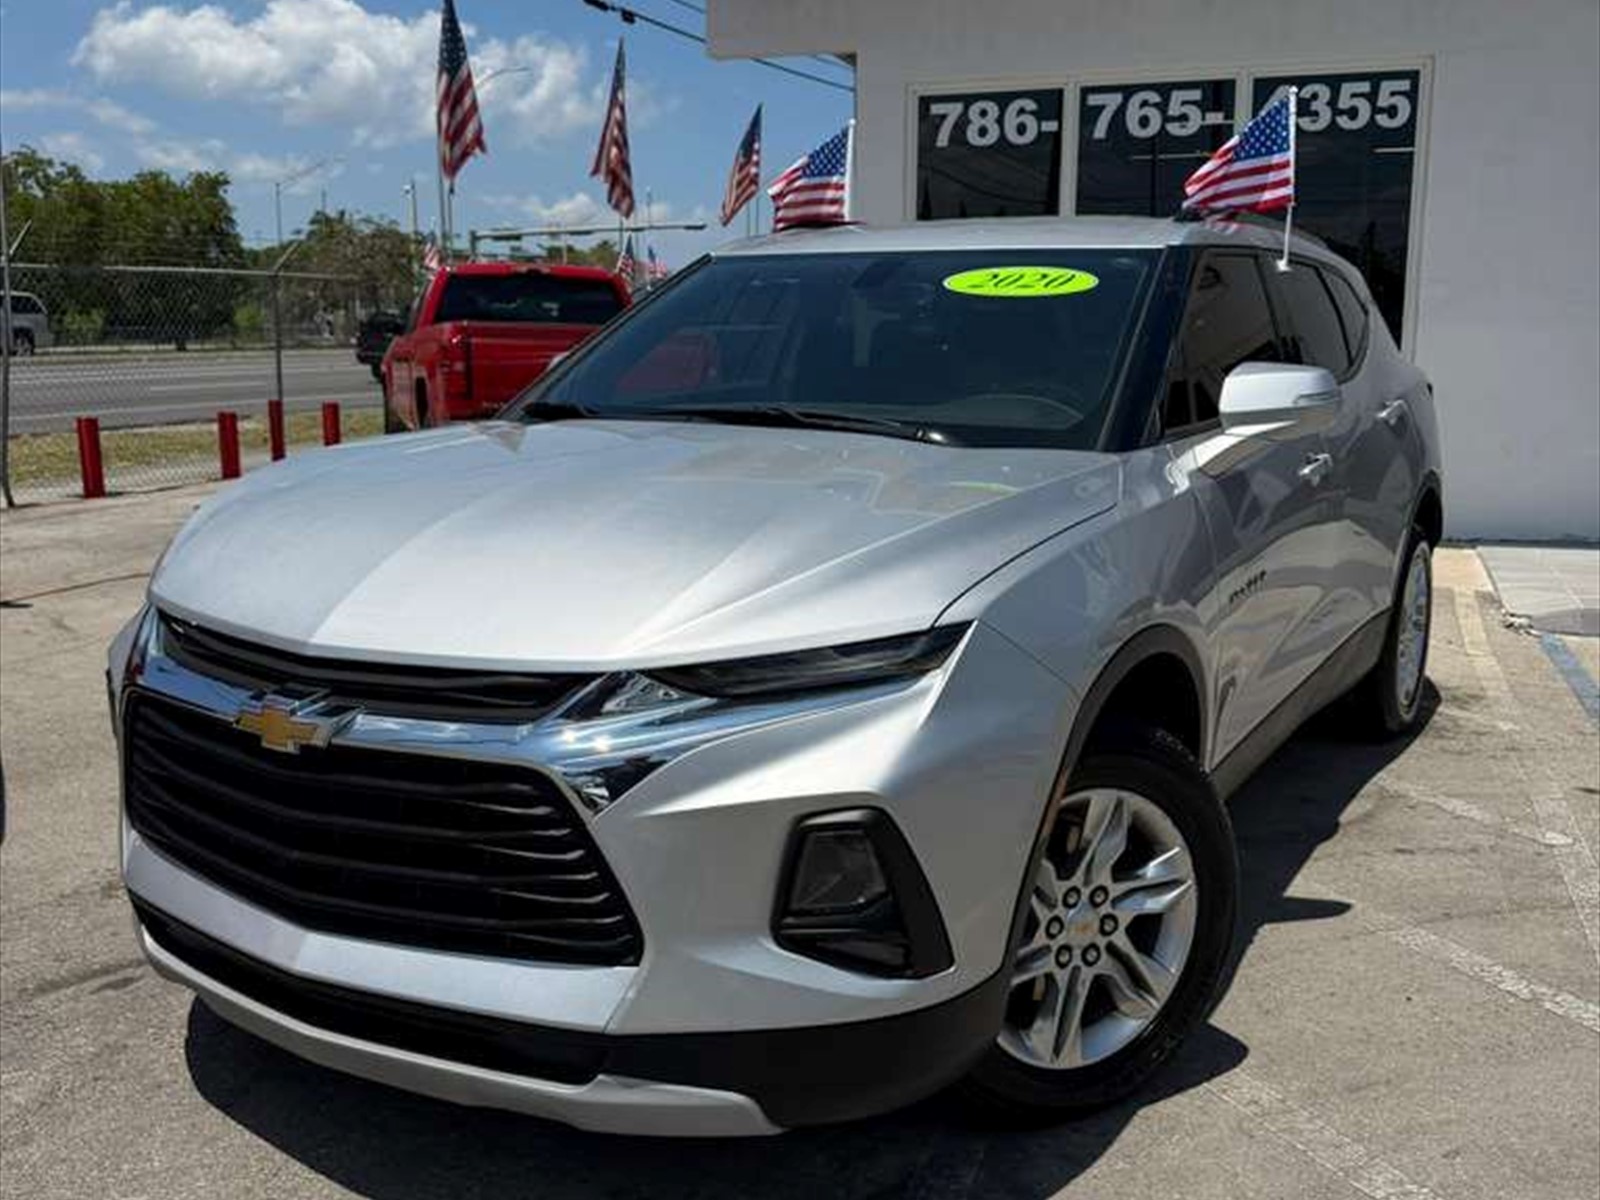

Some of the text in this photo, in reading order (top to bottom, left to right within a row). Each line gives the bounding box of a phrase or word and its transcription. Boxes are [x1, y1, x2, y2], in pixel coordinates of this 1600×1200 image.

[929, 97, 1059, 148] 786-
[1086, 88, 1225, 140] 765-
[966, 272, 1076, 289] 2020
